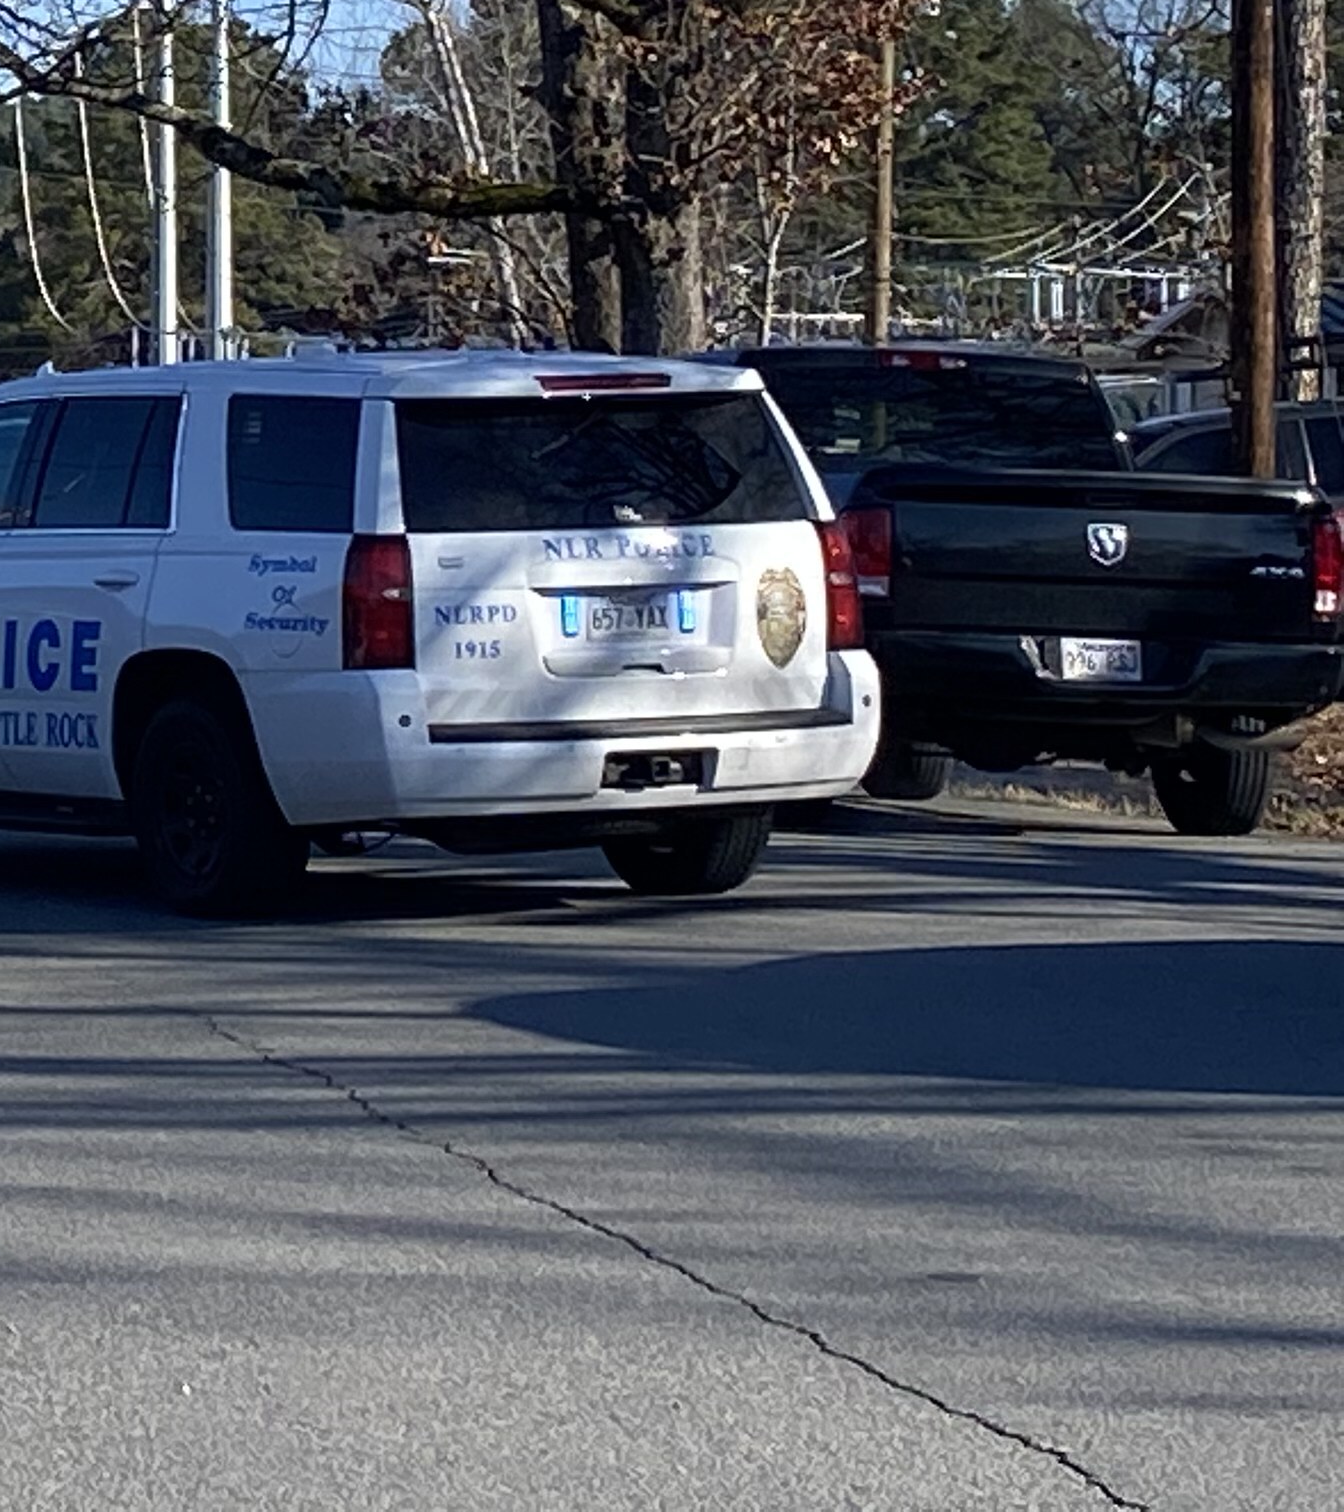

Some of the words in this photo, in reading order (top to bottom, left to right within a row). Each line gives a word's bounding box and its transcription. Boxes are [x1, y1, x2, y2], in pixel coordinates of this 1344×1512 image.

[542, 537, 603, 560] NLR
[248, 554, 318, 576] Symbol
[244, 612, 330, 636] Security
[434, 604, 517, 626] NLRPD
[592, 607, 624, 631] 657
[454, 640, 502, 659] 1915
[45, 711, 100, 750] ROCK
